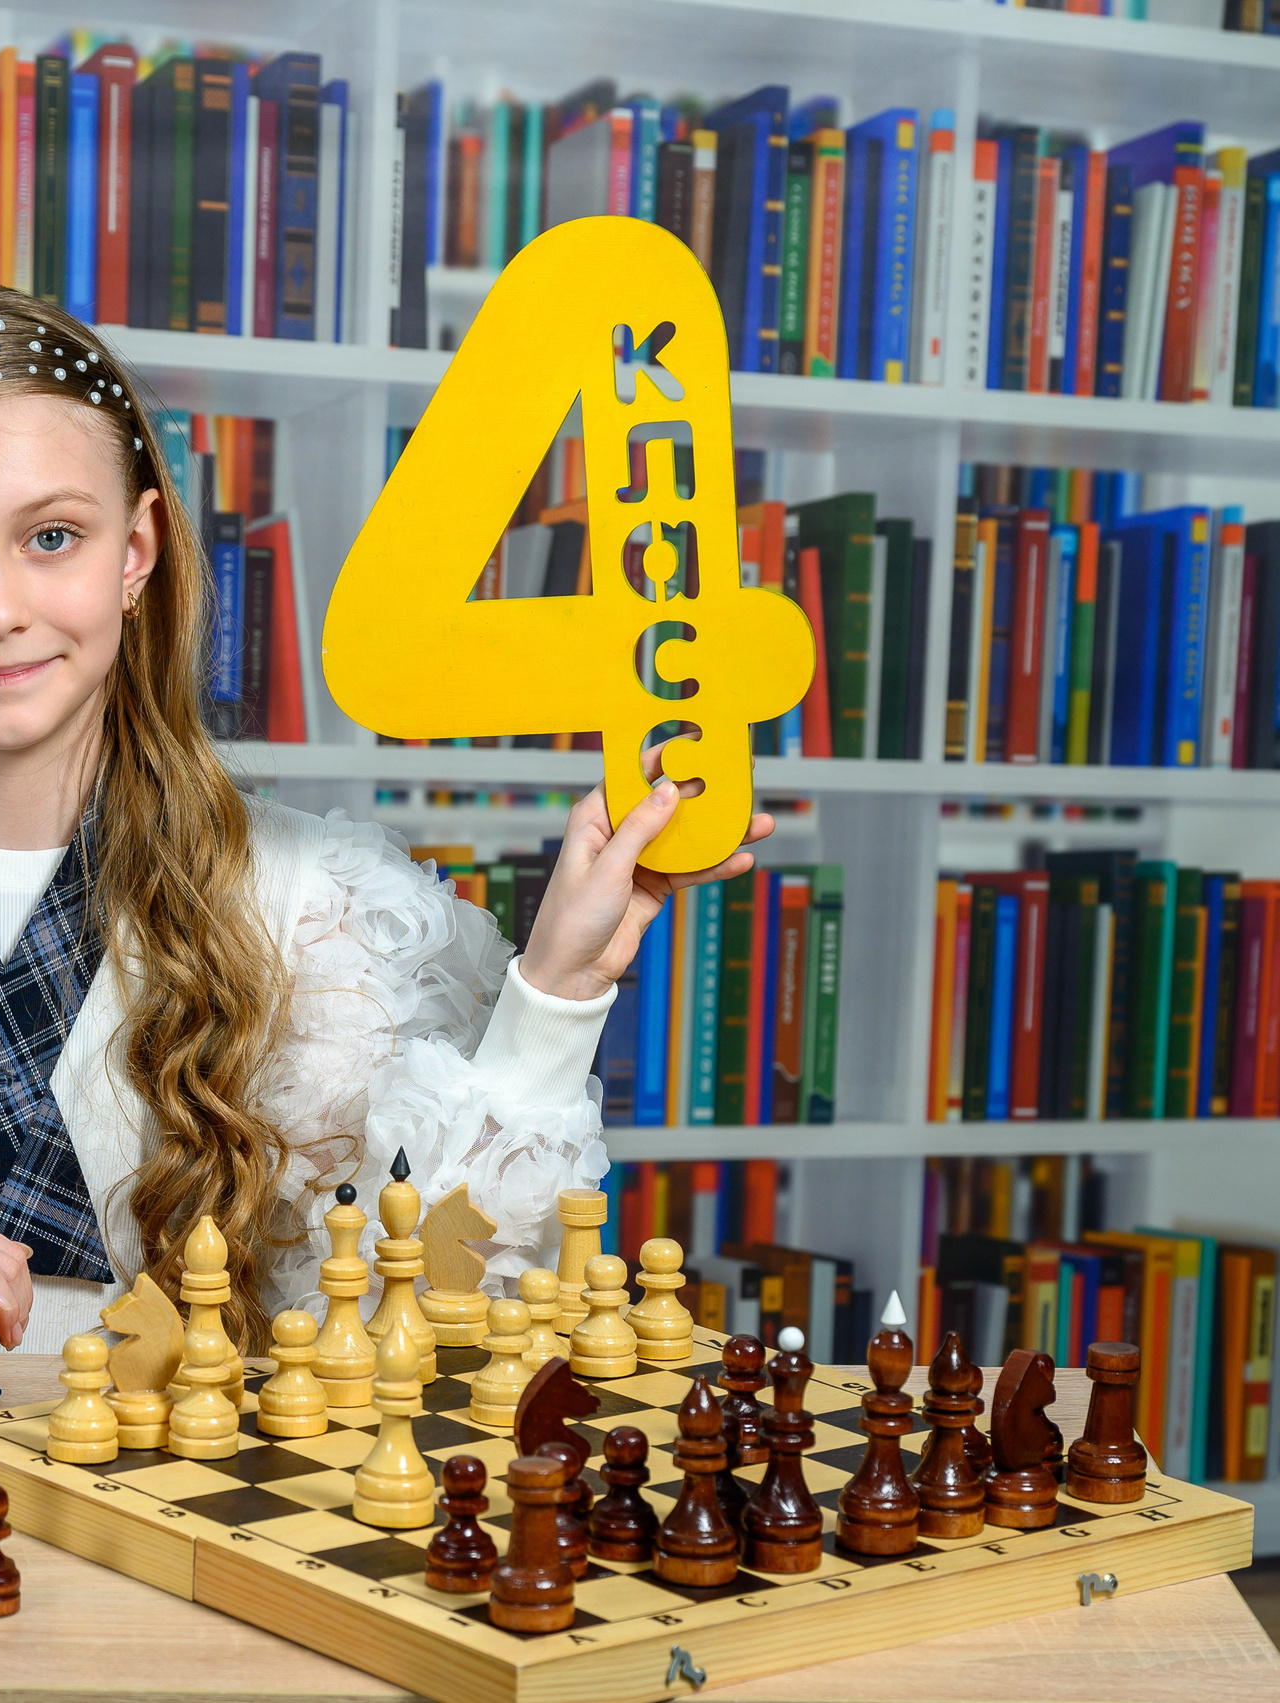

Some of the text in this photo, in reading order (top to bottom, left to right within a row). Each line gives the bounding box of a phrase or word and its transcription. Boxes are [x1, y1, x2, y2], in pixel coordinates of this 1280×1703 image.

[968, 189, 987, 383] STATISTICS
[323, 215, 815, 875] 4
[699, 885, 720, 1093] CONSTRUCTION
[781, 928, 799, 1025] Literature
[821, 921, 838, 994] HISTORY
[30, 1456, 54, 1467] 7
[158, 1507, 187, 1518] 5
[230, 1532, 259, 1543] 4
[296, 1559, 327, 1571] 3
[368, 1587, 401, 1600] 2
[447, 1616, 473, 1628] 1
[567, 1509, 1174, 1646] A B C D E F G H
